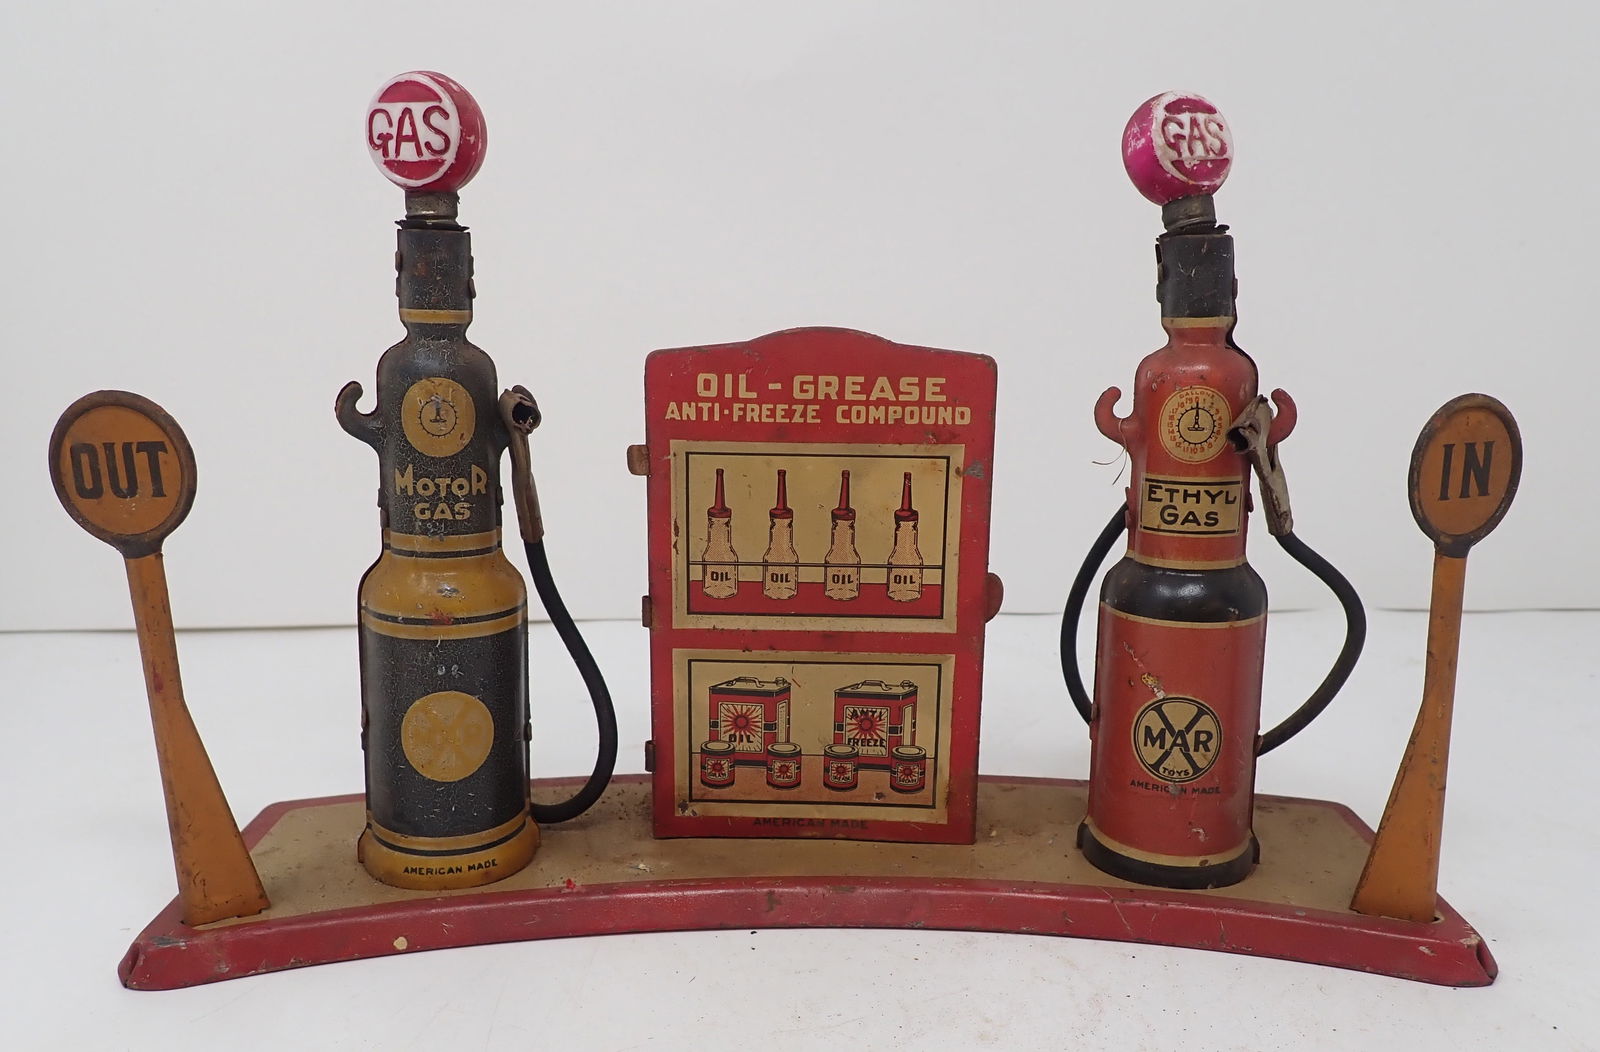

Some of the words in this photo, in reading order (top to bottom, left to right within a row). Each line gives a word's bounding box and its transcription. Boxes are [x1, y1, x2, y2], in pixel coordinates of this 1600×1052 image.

[368, 105, 451, 158] GAS
[1161, 115, 1228, 158] GAS
[696, 373, 758, 398] OIL
[793, 375, 947, 402] GREASE
[836, 405, 972, 426] COMPOUND
[69, 441, 169, 500] OUT
[1438, 440, 1496, 501] IN
[394, 463, 488, 497] MOTOR
[1147, 483, 1238, 505] ETHYL
[413, 502, 472, 520] GAS
[1159, 504, 1220, 527] GAS
[710, 570, 732, 583] OIL
[770, 572, 791, 584] OIL
[831, 573, 854, 585] OIL
[893, 574, 916, 585] OIL
[728, 733, 754, 744] OIL
[847, 737, 887, 748] FREEZE
[1143, 725, 1214, 753] MAR
[1162, 766, 1190, 777] TOYS
[1130, 779, 1187, 795] AMERICN
[1191, 785, 1222, 795] MADE
[753, 817, 825, 828] AMERICAN
[830, 819, 869, 830] MADE
[403, 865, 463, 876] AMERICAN
[467, 858, 498, 872] MADE
